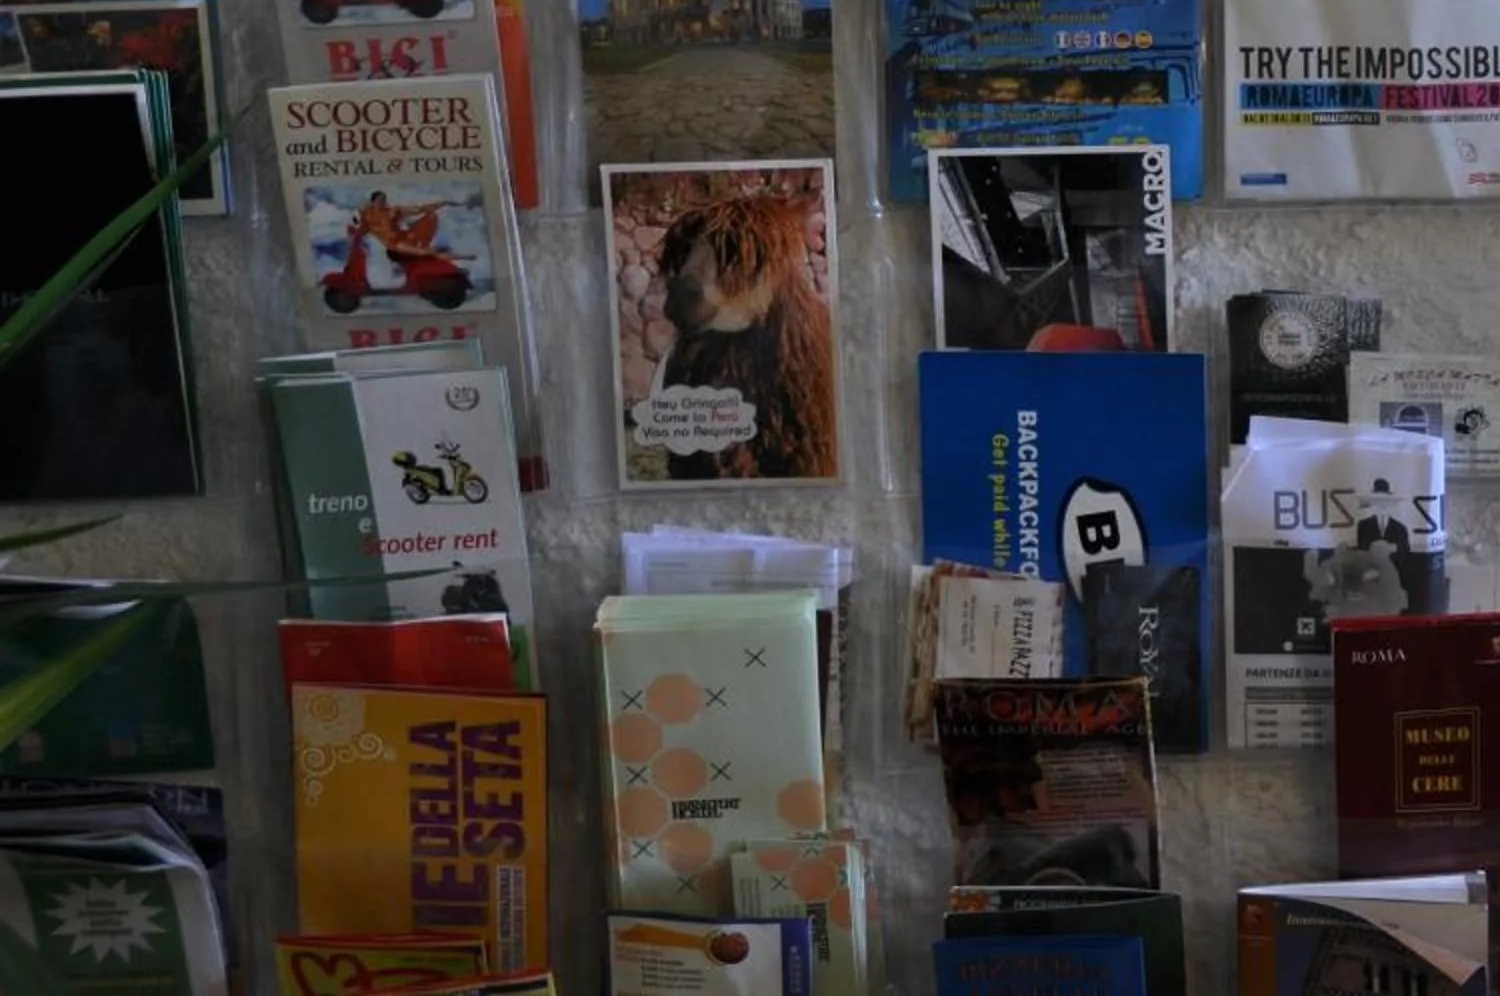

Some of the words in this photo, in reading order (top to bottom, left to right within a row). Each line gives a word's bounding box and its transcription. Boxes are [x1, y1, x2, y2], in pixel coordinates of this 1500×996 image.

[1239, 46, 1292, 80] TRY
[1299, 46, 1351, 80] THE
[1246, 84, 1375, 109] ROMAEUROPA
[1384, 83, 1471, 109] FESTIVAL
[287, 97, 473, 130] SCOOTER
[286, 134, 328, 156] and
[336, 124, 482, 154] BICYCLE
[294, 157, 382, 178] RENTAL
[408, 155, 484, 175] TOURS
[1141, 149, 1168, 257] MACRO
[652, 412, 690, 424] Come
[693, 411, 707, 423] to
[642, 426, 669, 439] Visa
[673, 426, 691, 438] no
[992, 433, 1011, 469] Get
[308, 492, 369, 515] treno
[988, 474, 1011, 512] paid
[359, 518, 373, 535] e
[361, 532, 446, 559] scooter
[453, 529, 499, 551] rent
[1351, 647, 1409, 666] ROMA
[1404, 724, 1471, 746] MUSEO
[408, 721, 460, 859] DELLA
[461, 720, 525, 860] SETA
[1411, 773, 1465, 794] CERE
